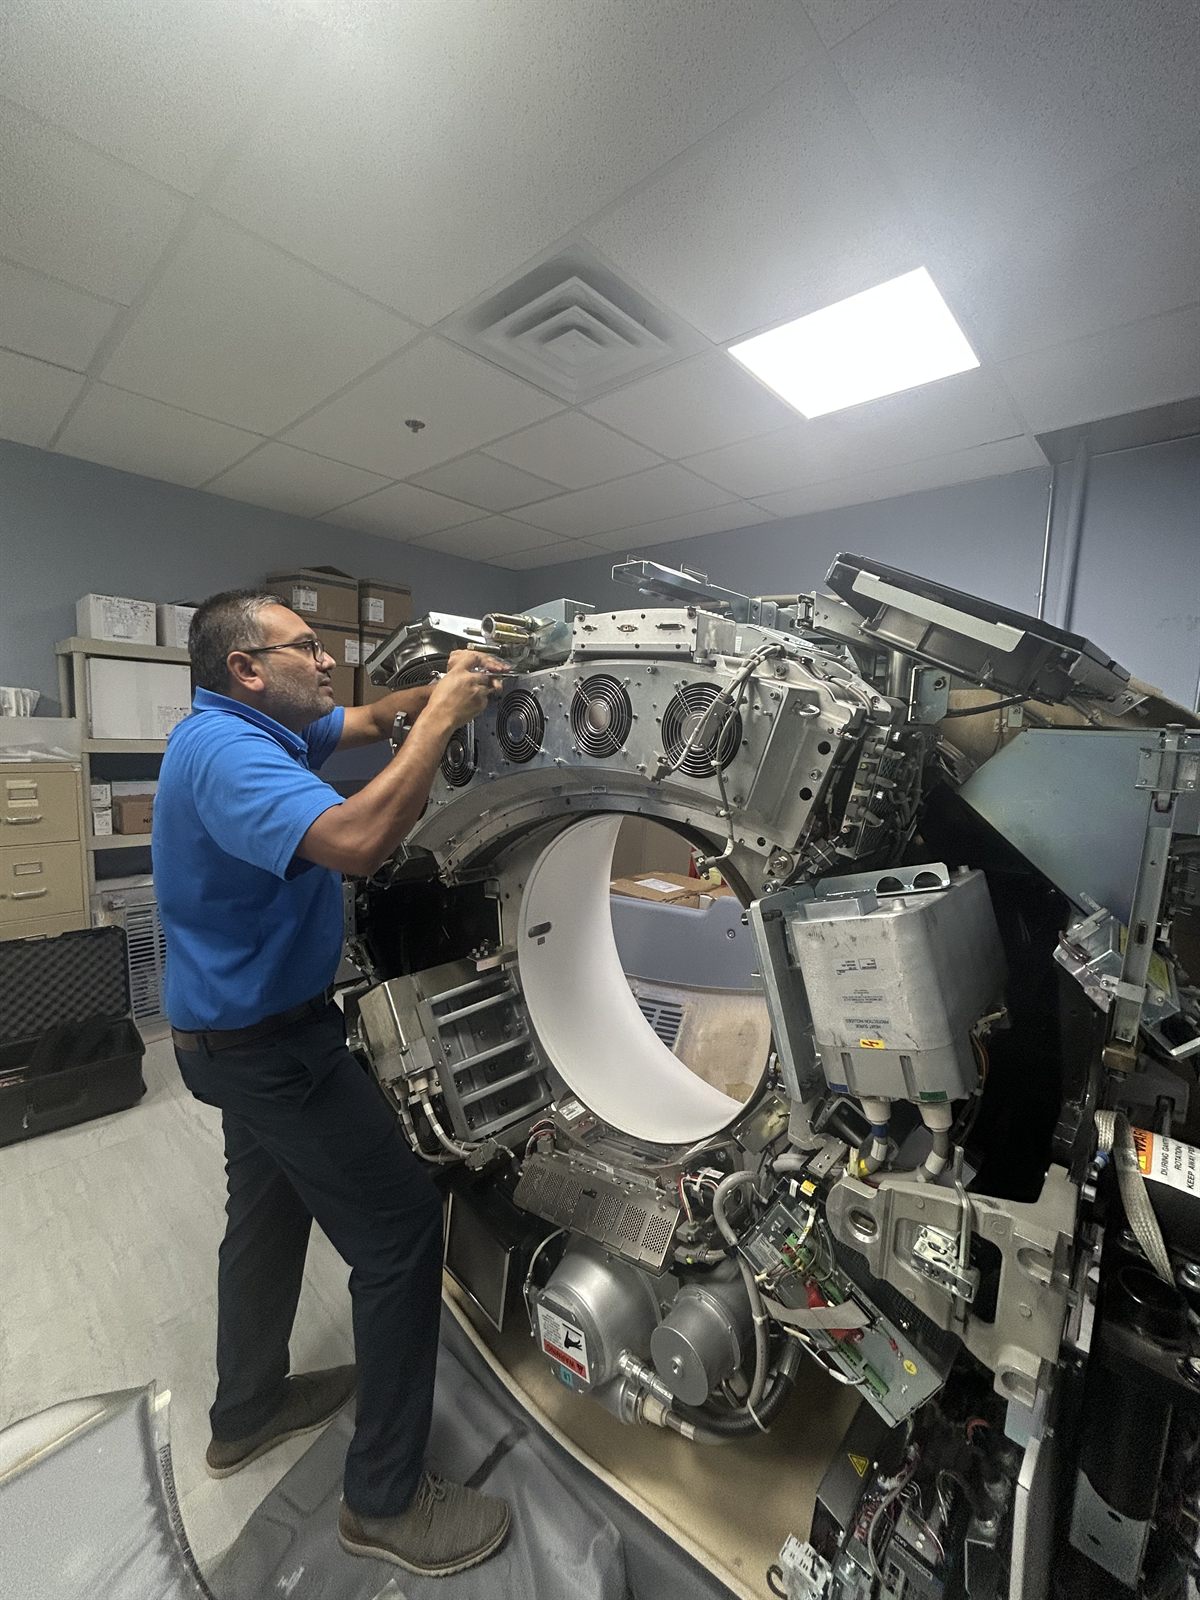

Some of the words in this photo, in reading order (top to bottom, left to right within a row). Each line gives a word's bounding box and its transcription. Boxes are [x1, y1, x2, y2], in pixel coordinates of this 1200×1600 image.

[1160, 1152, 1169, 1176] DURING
[1174, 1145, 1182, 1171] ROTATION
[1188, 1155, 1196, 1171] AWAY
[1186, 1170, 1195, 1190] KEEP
